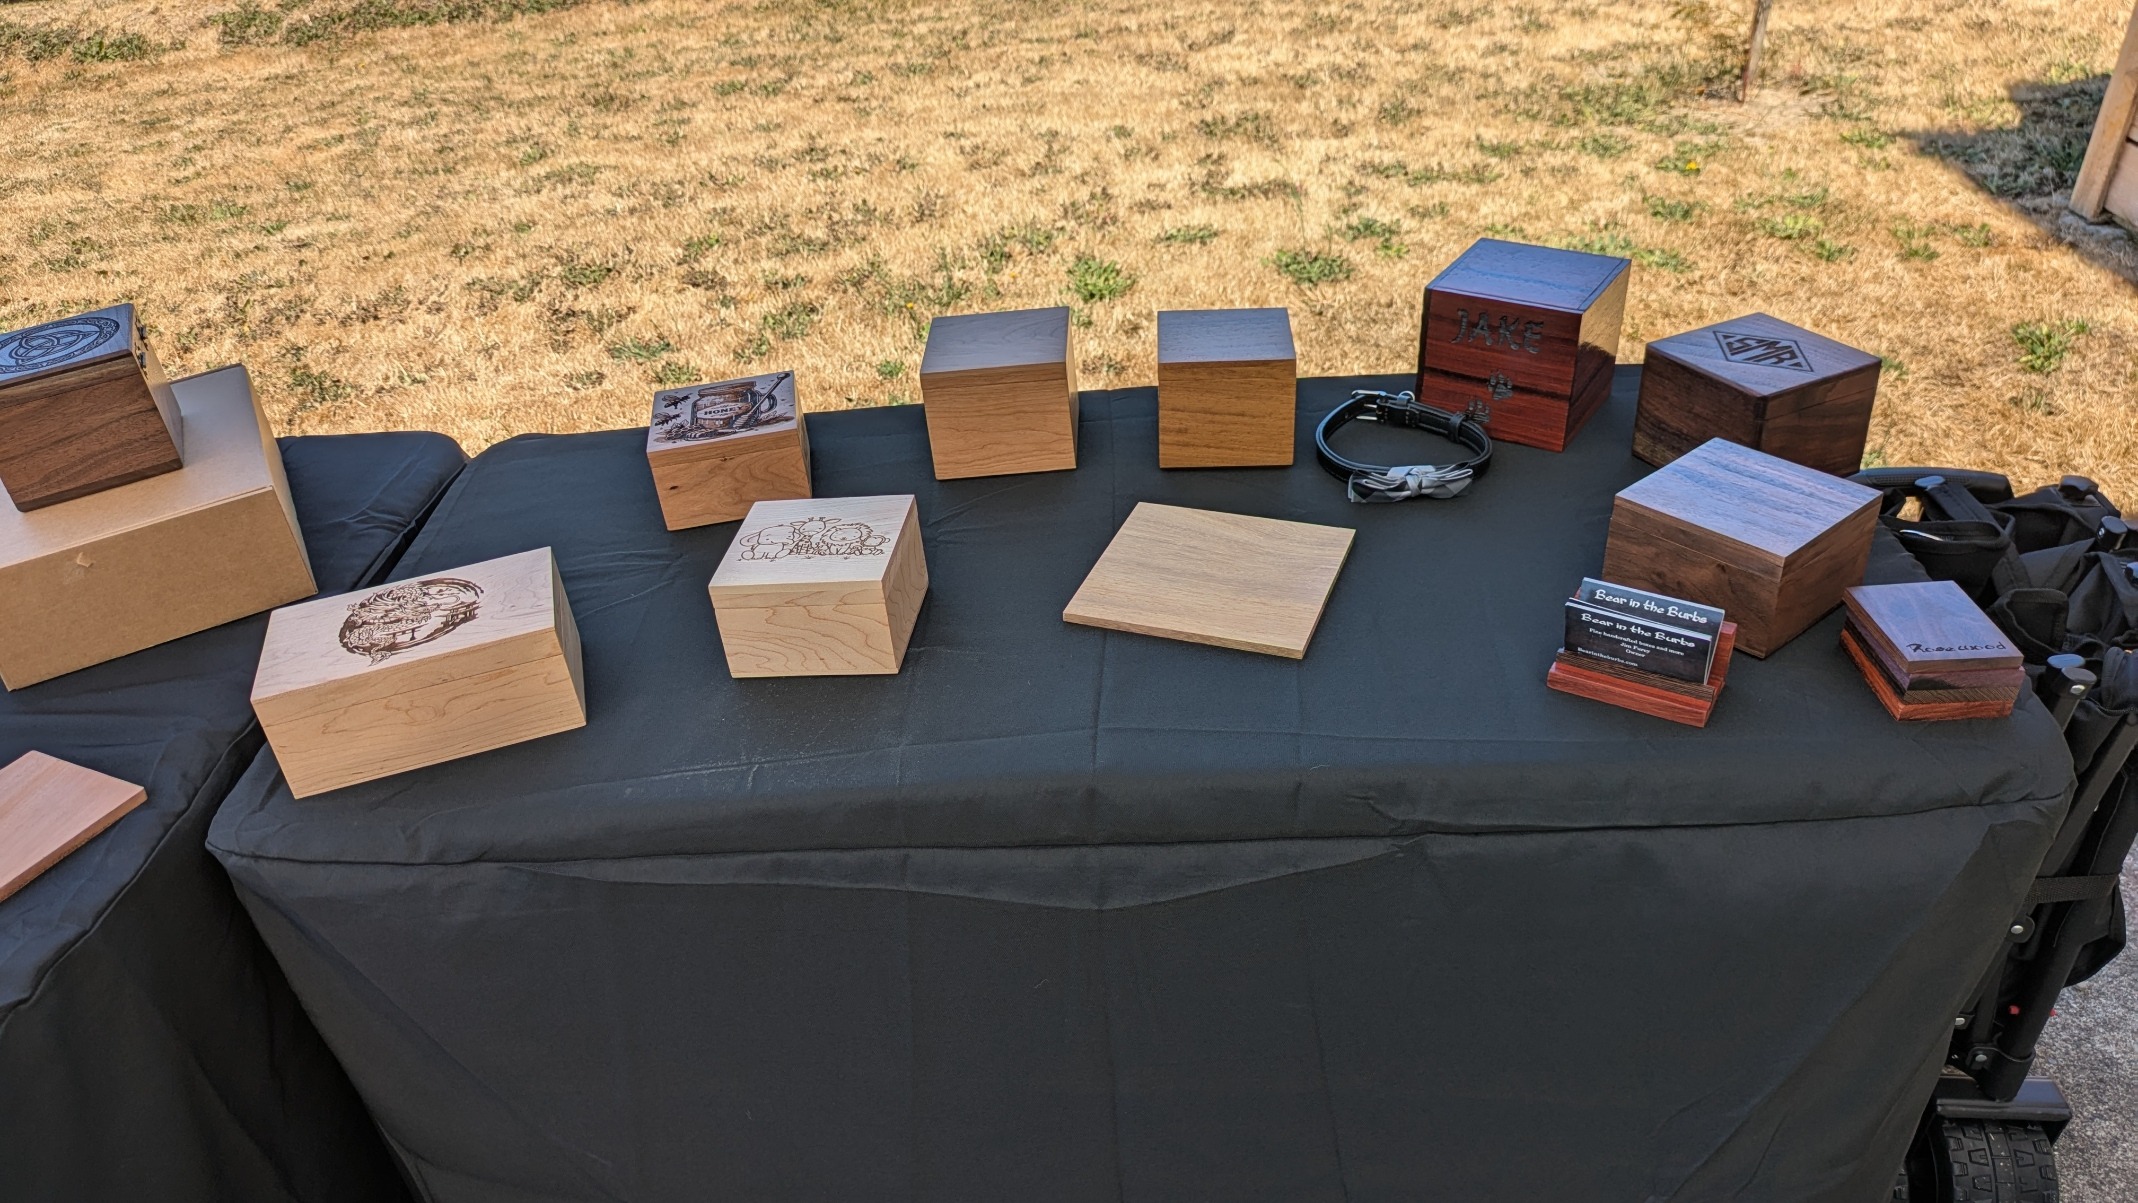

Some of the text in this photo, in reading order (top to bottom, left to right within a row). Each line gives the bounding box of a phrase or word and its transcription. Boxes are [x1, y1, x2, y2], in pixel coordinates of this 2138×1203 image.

[1450, 308, 1544, 354] JAKE
[704, 406, 742, 416] HONEY
[1594, 589, 1708, 624] Bear in the Burbs
[1581, 613, 1695, 648] Bear in the Burbs
[1603, 631, 1638, 644] handcrafted
[1639, 640, 1656, 649] boxes
[1625, 649, 1646, 658] Owner
